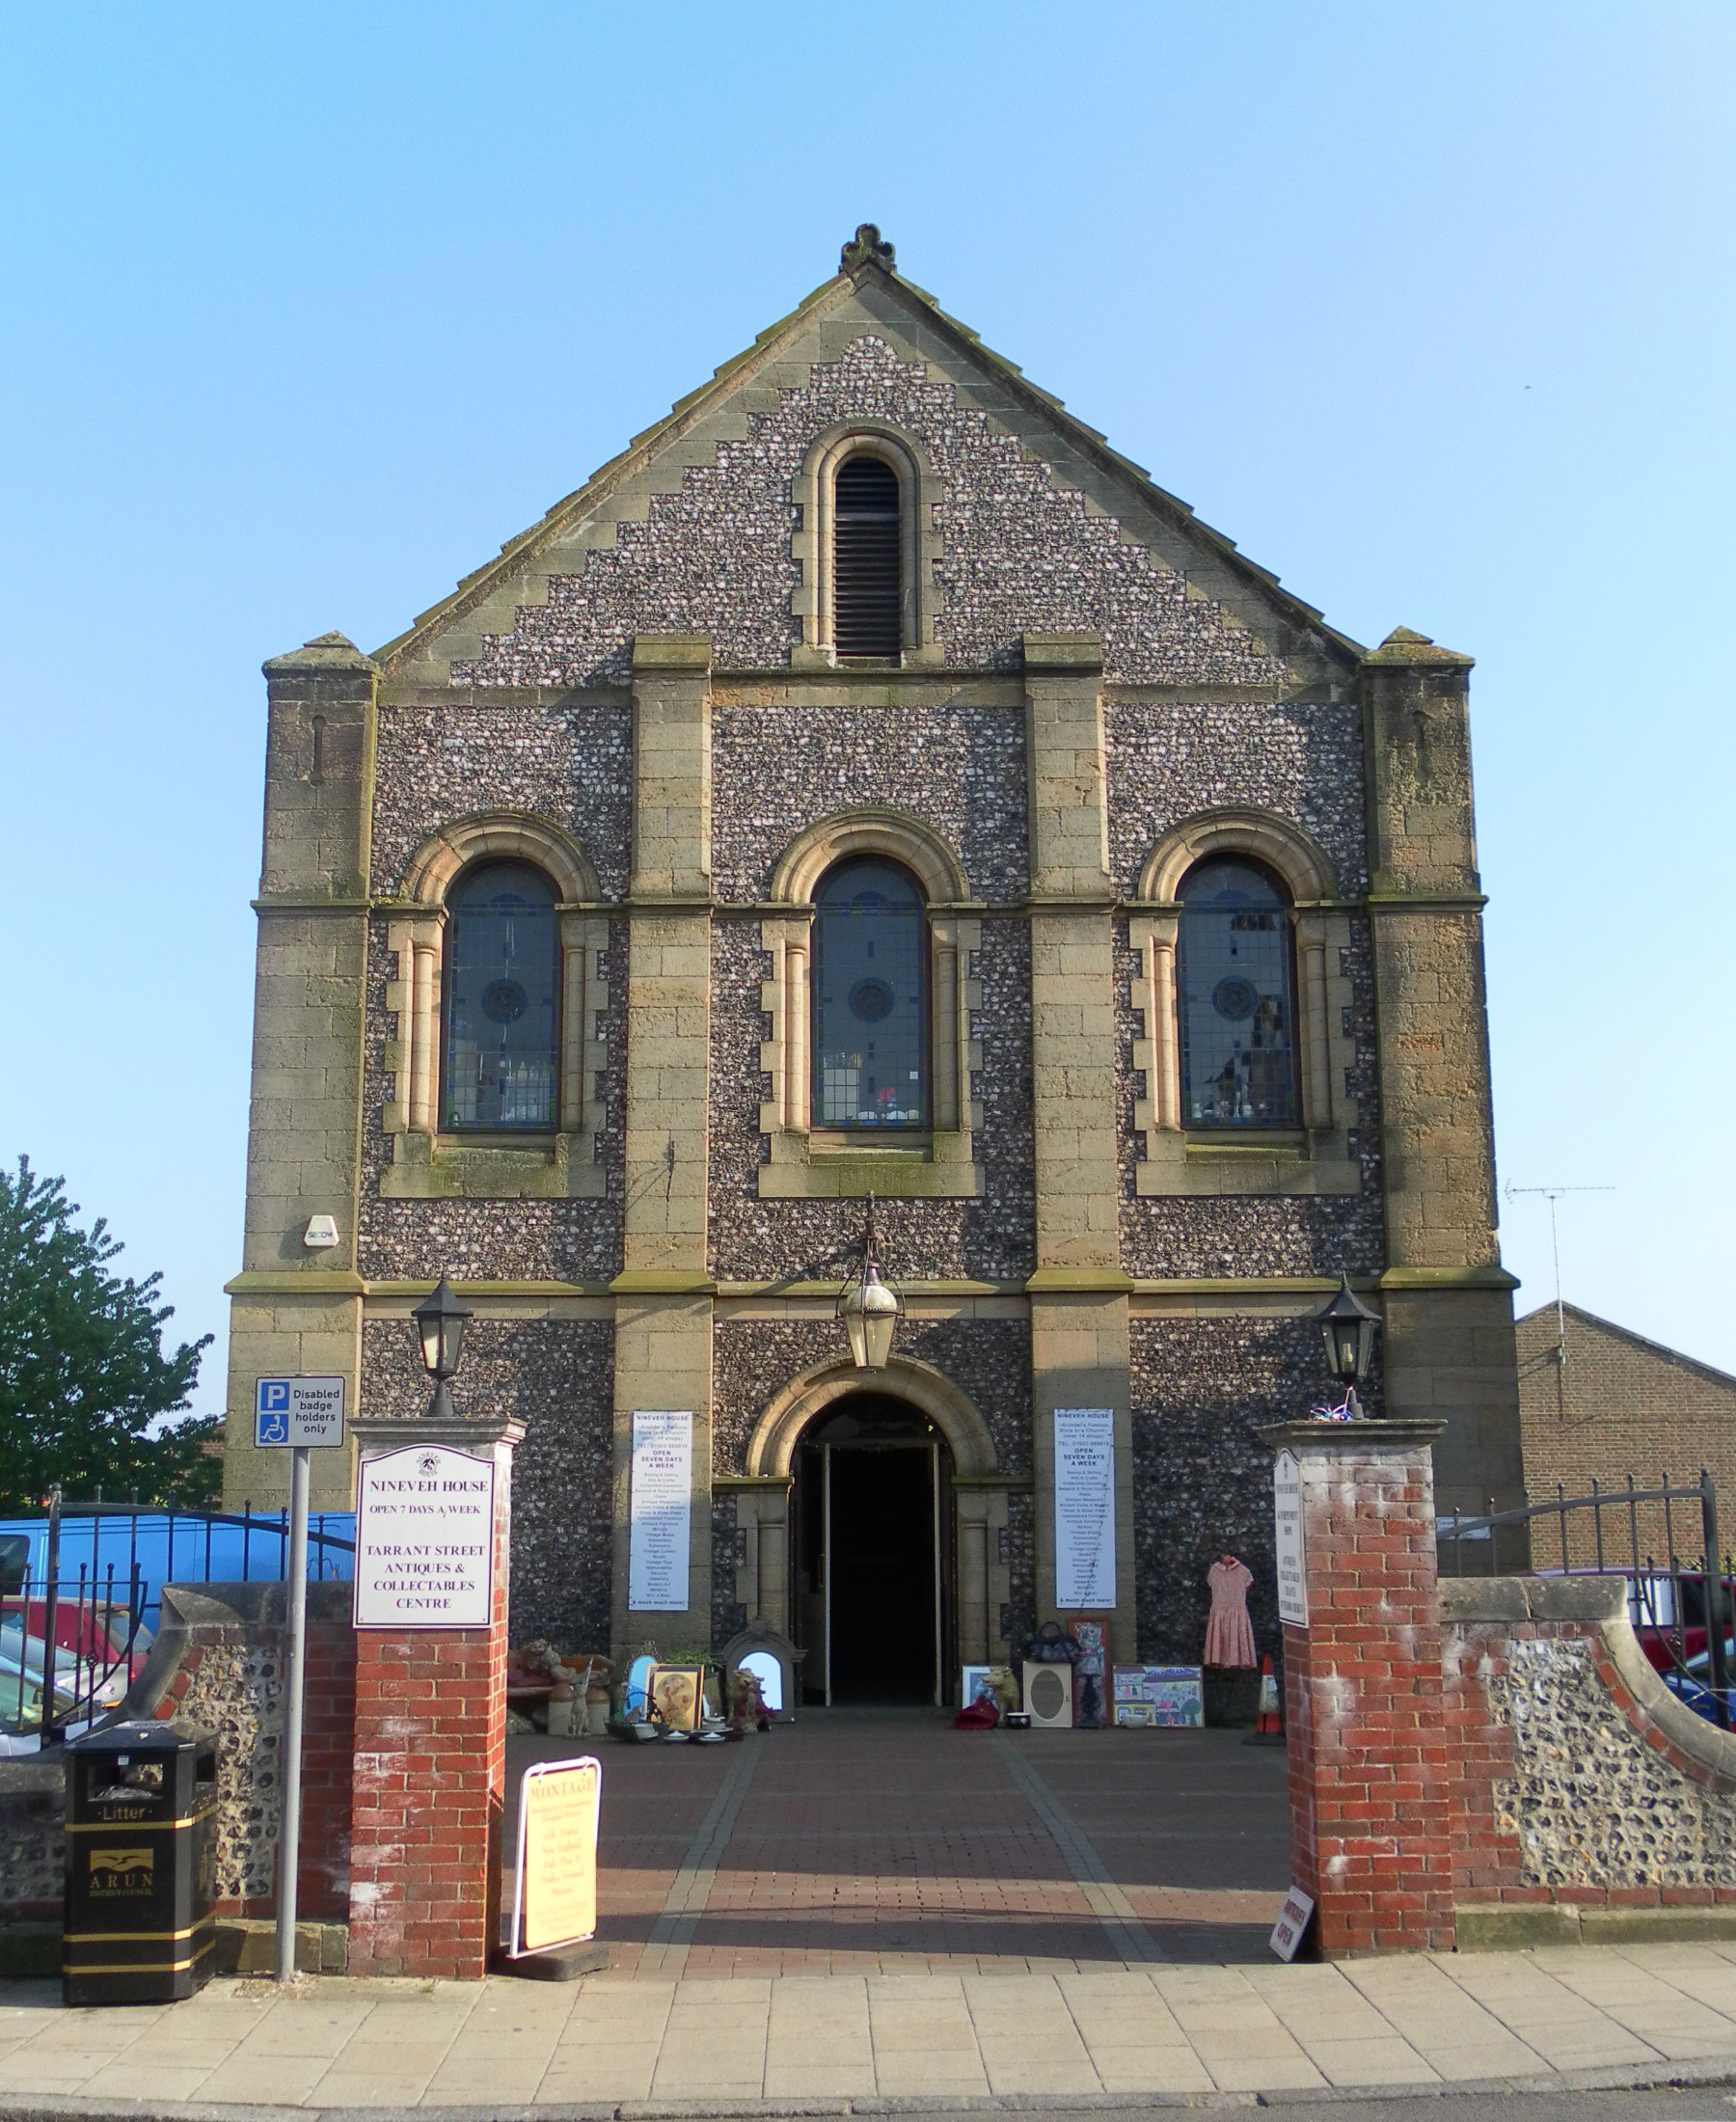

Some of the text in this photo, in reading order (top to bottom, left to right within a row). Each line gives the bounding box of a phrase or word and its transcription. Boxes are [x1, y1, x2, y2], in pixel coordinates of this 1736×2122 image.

[293, 1389, 340, 1399] Disabled
[300, 1401, 333, 1411] badge
[295, 1412, 336, 1422] holders
[304, 1424, 327, 1434] only
[370, 1481, 488, 1491] NINEVEH HOUSE
[369, 1505, 397, 1513] OPEN
[400, 1505, 406, 1513] 7
[409, 1505, 434, 1513] DAYS
[366, 1545, 486, 1556] TARRANT STREET
[385, 1563, 465, 1575] ANTIQUES &
[373, 1581, 475, 1592] COLLECTABLES
[396, 1598, 451, 1609] CENTRE
[102, 1806, 146, 1821] Litter
